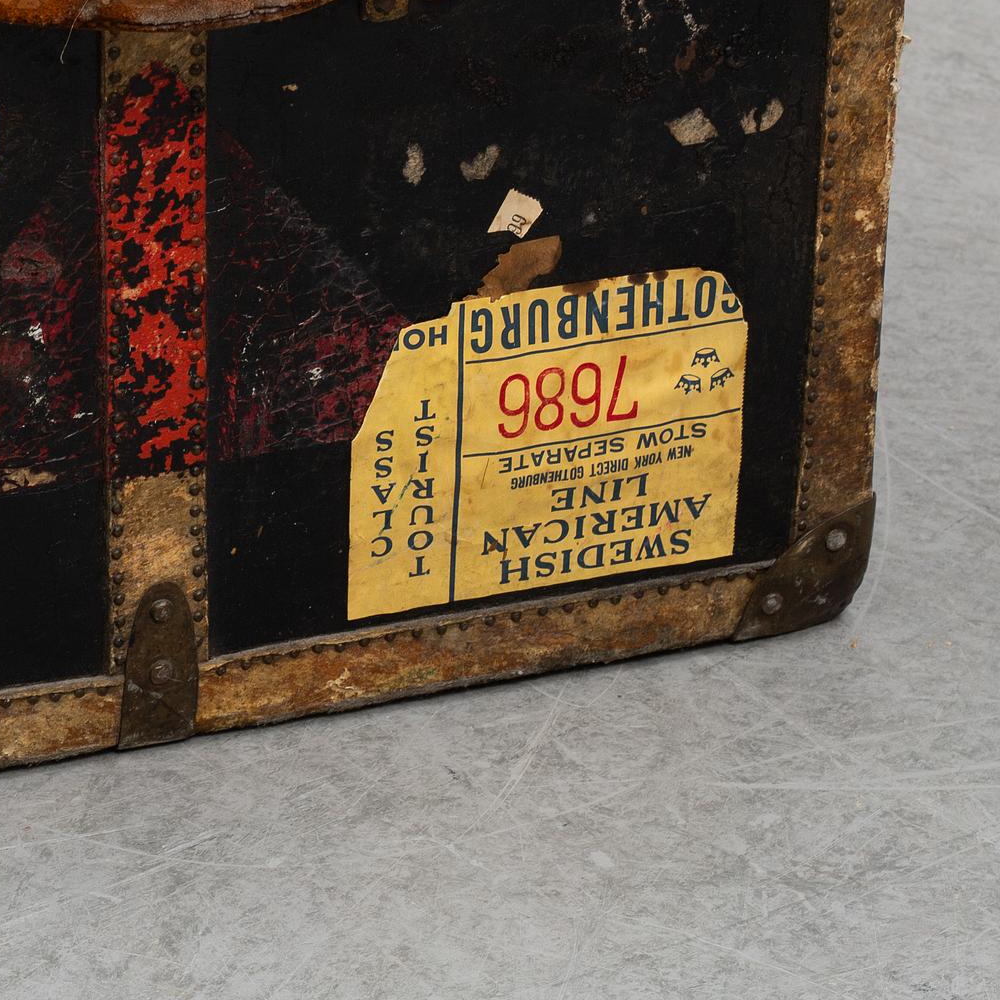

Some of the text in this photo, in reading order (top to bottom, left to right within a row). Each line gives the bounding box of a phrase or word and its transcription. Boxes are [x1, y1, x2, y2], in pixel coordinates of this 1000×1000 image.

[394, 324, 448, 352] HO
[498, 355, 639, 439] 7686
[498, 422, 708, 474] STOW SEPARATE
[511, 444, 693, 490] NEW YORK DIRECT GOTHENBURG
[370, 430, 396, 558] CLASS
[407, 400, 436, 578] TOURIST
[550, 473, 649, 513] LINE
[481, 493, 712, 556] AMERICAN
[499, 529, 692, 585] SWEDISH
